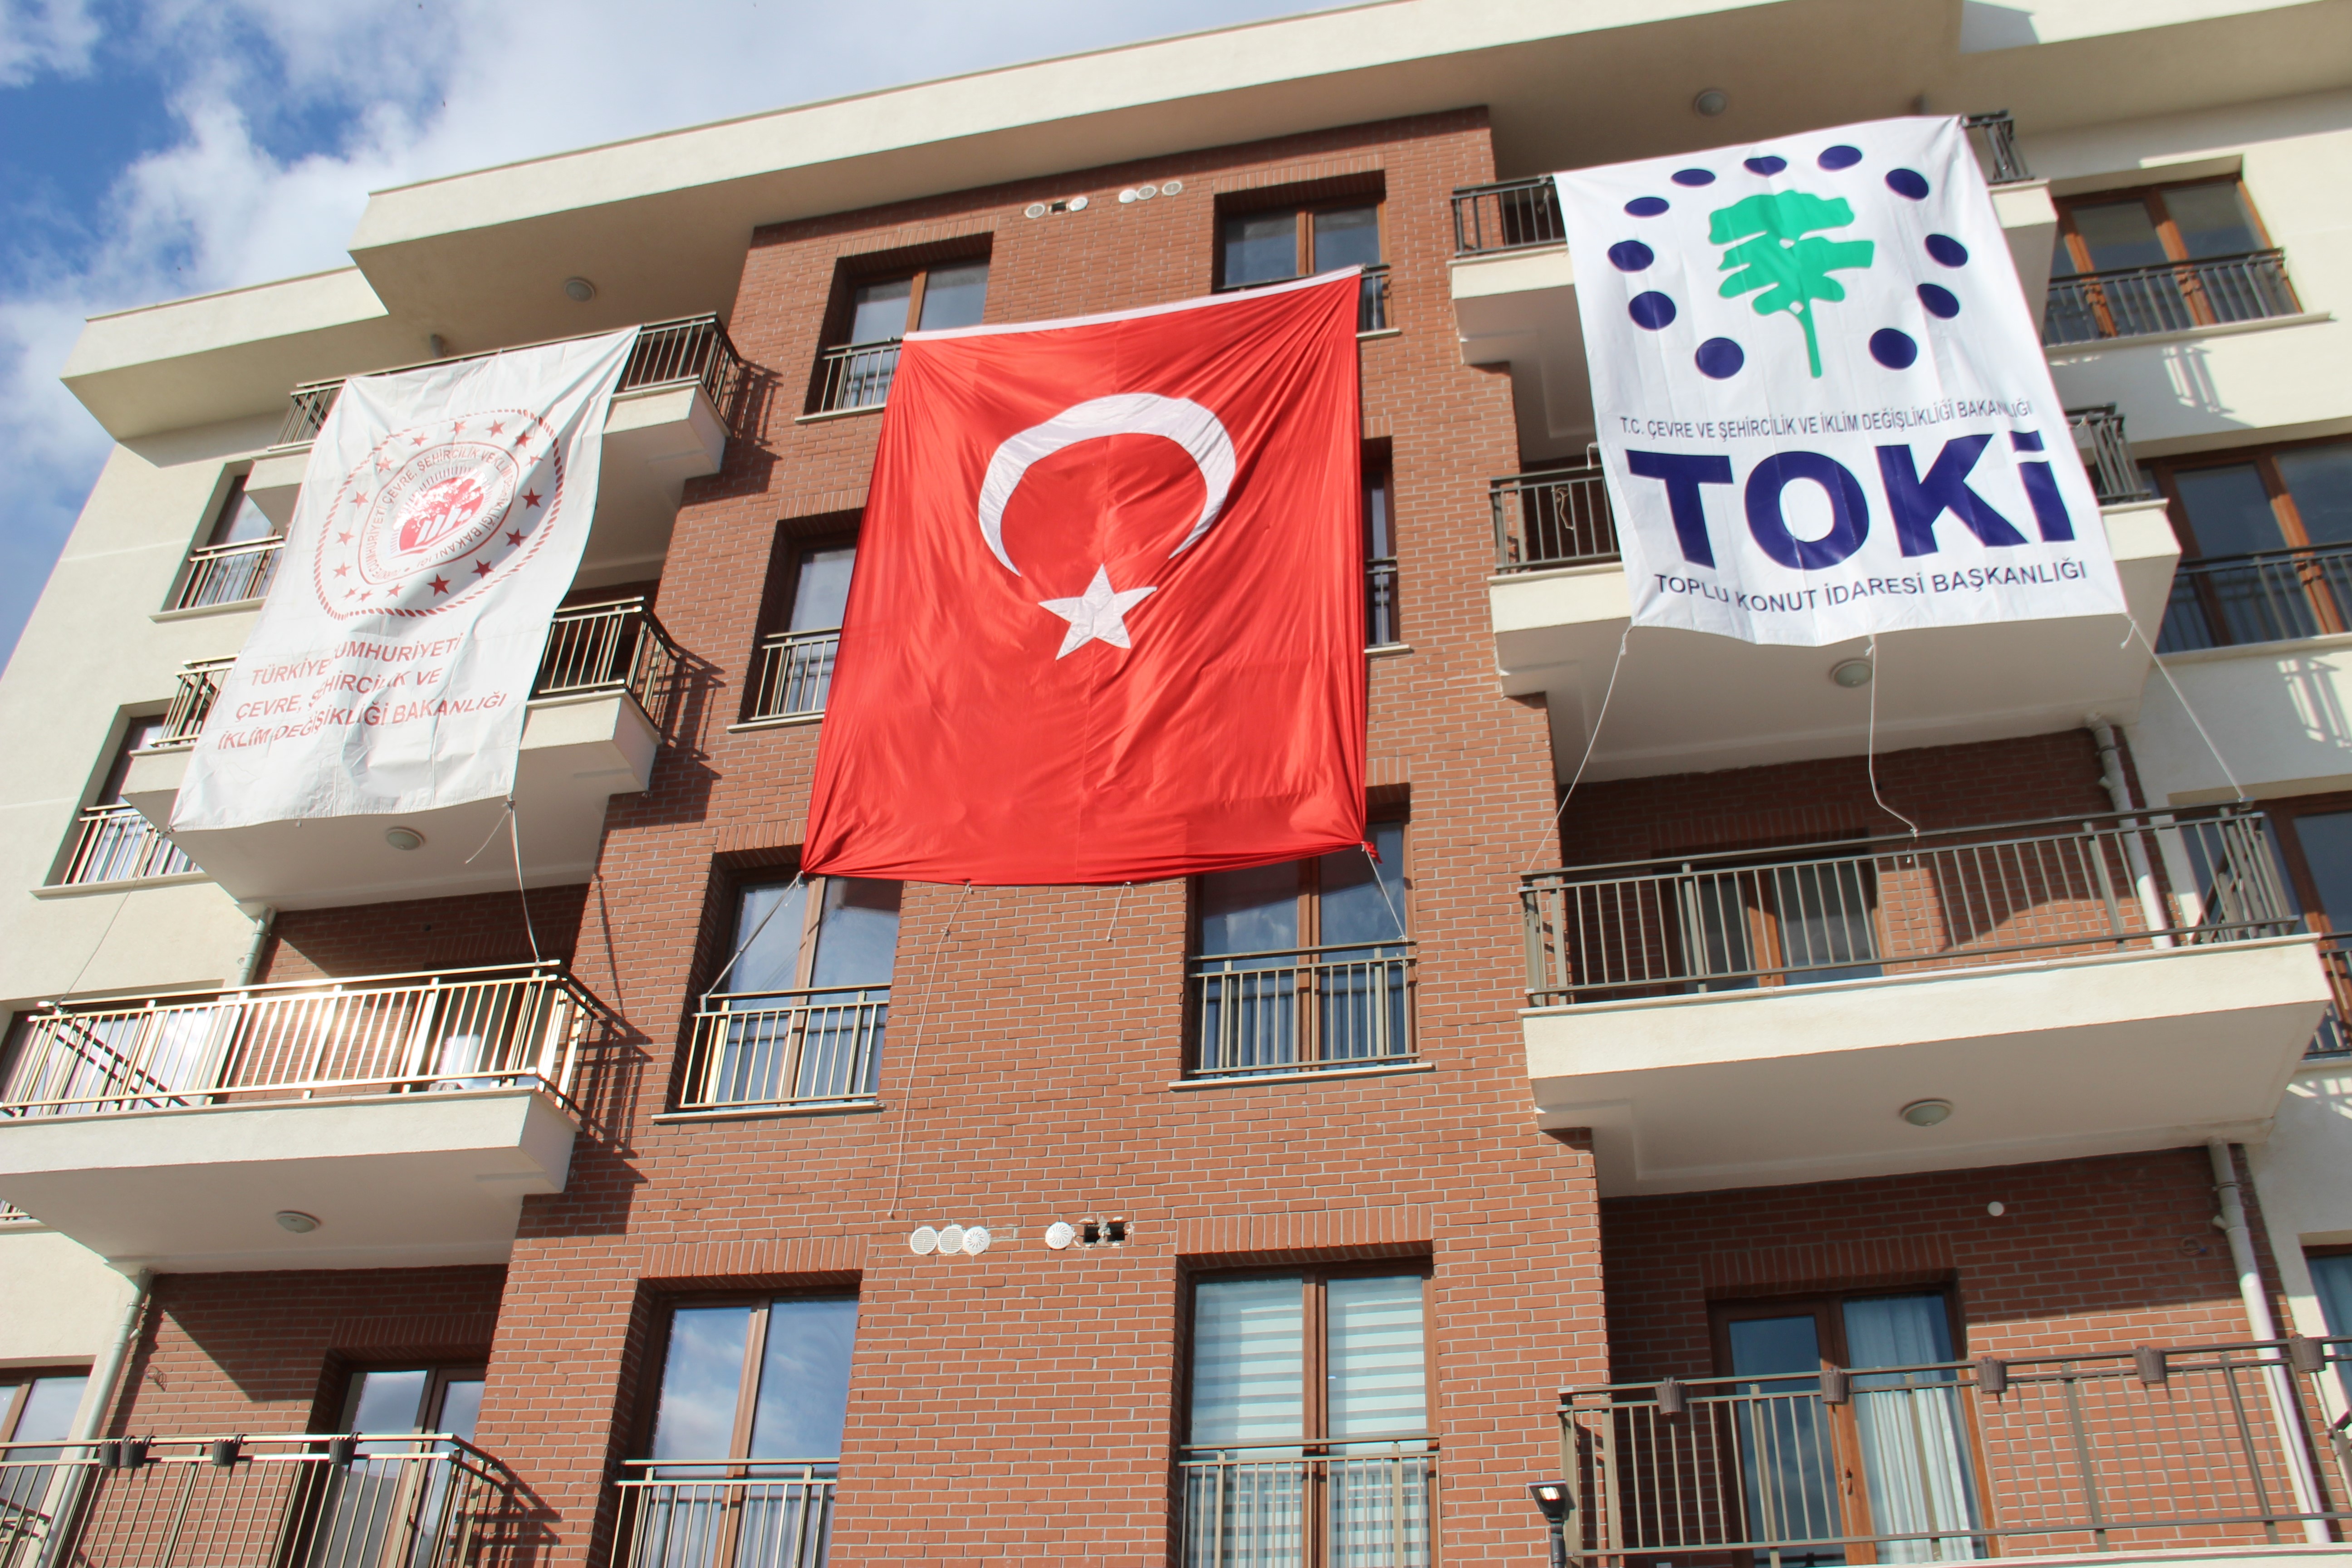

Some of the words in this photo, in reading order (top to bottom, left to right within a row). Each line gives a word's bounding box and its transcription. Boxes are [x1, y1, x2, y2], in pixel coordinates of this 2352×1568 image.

[1620, 416, 1644, 435] T.C.
[1647, 420, 1693, 439] ÇEVRE
[1696, 422, 1715, 438] VE
[1719, 413, 1796, 442] ŞEHİRCİLİK
[1798, 416, 1818, 434] VE
[1820, 410, 1858, 432] İKLİM
[1862, 398, 1954, 432] DEĞİŞLİKLİĞİ
[1956, 397, 2033, 418] BAKANLIĞI
[382, 470, 418, 505] ÇEVRE,
[417, 446, 480, 473] ŞEHİRCİLİK
[1654, 573, 1729, 603] TOPLU
[1735, 588, 1817, 612] KONUT
[1823, 573, 1925, 606] İDARESİ
[1931, 557, 2087, 593] BAŞKANLIĞI
[251, 658, 331, 686] TÜRKİYE
[334, 632, 464, 662] UMHURİYETİ
[218, 727, 273, 750] İKLİM
[273, 701, 389, 741] DEĞİŞİKLİĞİ
[392, 691, 507, 725] BAKANLIĞI
[235, 695, 302, 723] ÇEVRE,
[416, 668, 443, 686] VE
